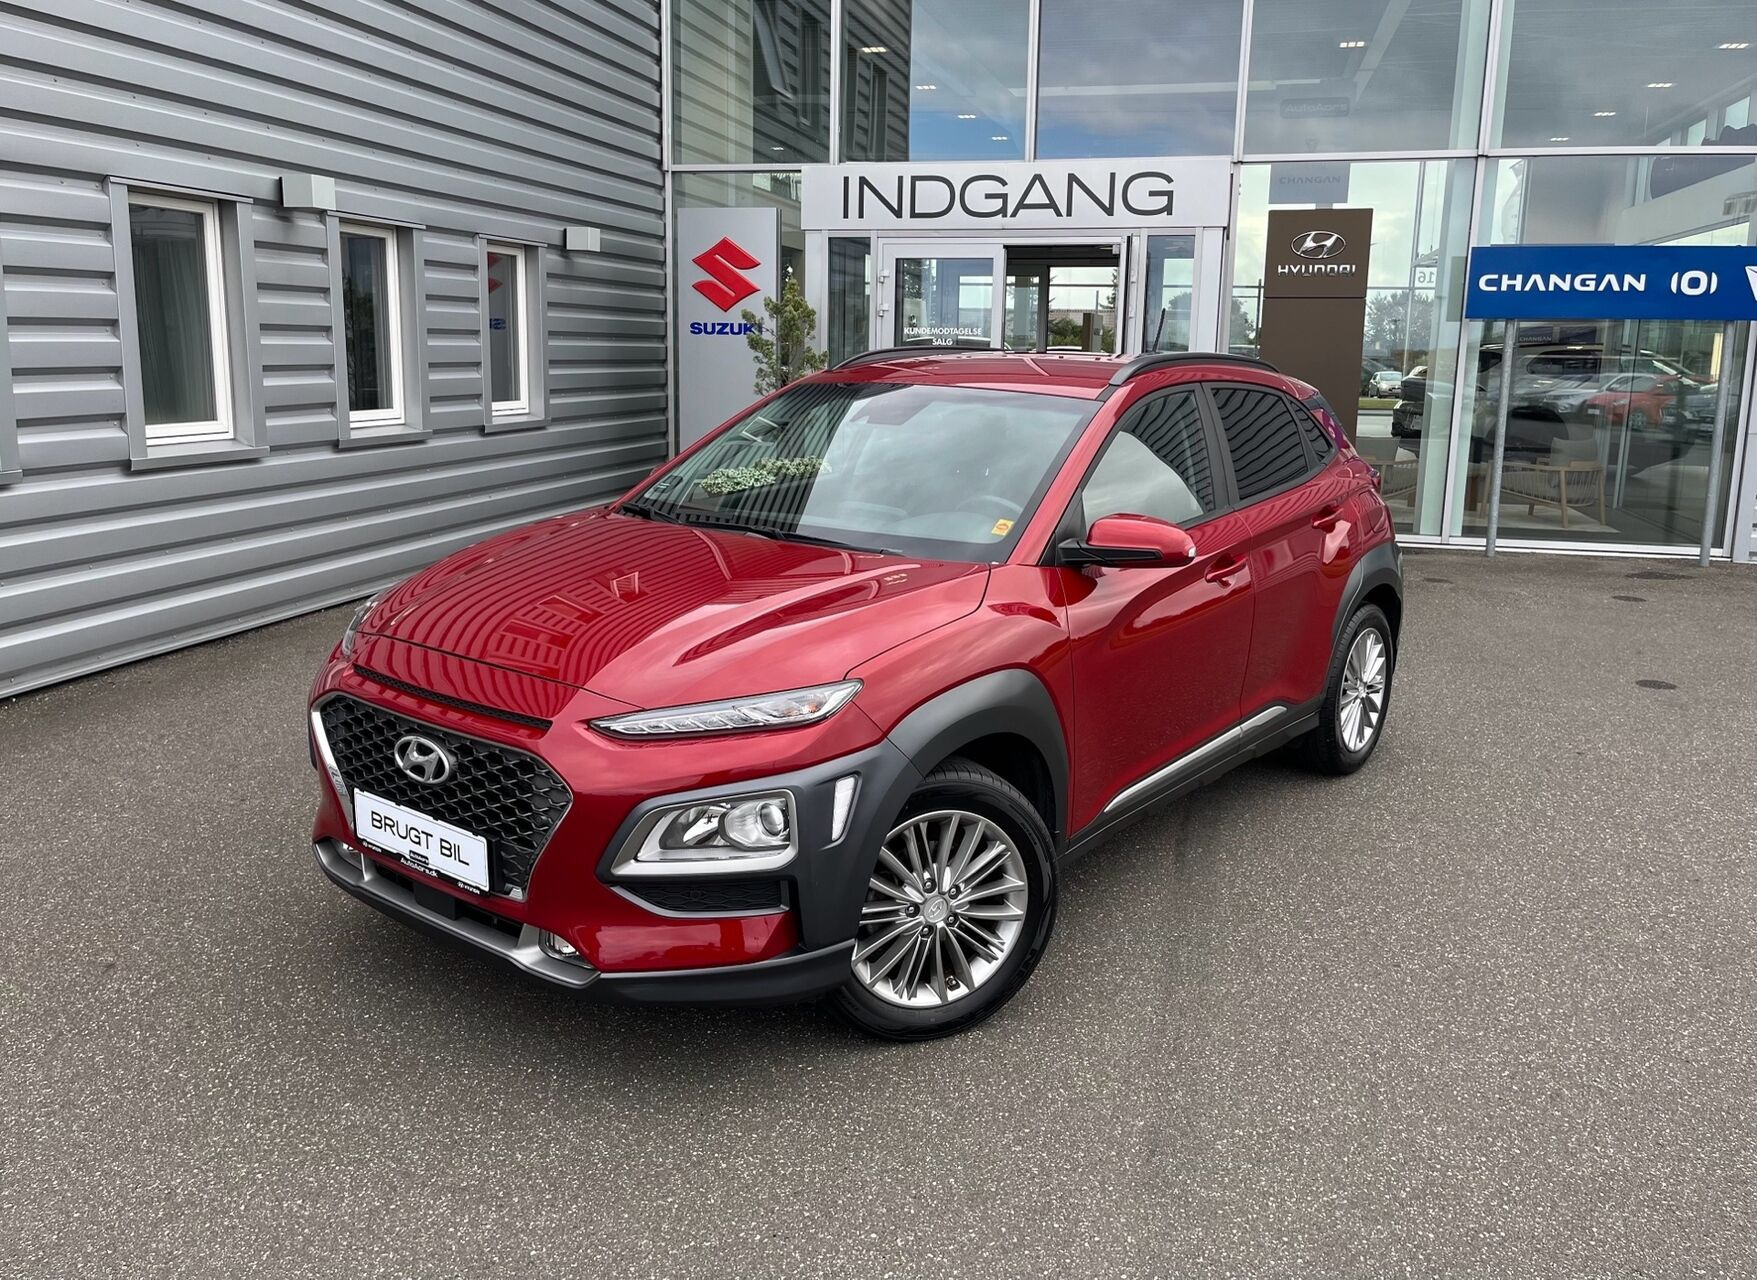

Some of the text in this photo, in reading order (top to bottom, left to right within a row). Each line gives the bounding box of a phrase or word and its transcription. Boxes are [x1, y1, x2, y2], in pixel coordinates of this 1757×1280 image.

[1280, 175, 1341, 184] CHANGAN
[842, 171, 1175, 219] INDGANG
[1277, 264, 1356, 277] HYUNDAI
[1478, 273, 1647, 292] CHANGAN
[903, 327, 983, 335] KUNDEMODTAGELSE
[931, 338, 953, 346] SALG
[371, 810, 433, 850] BRUGT
[440, 838, 470, 866] BIL
